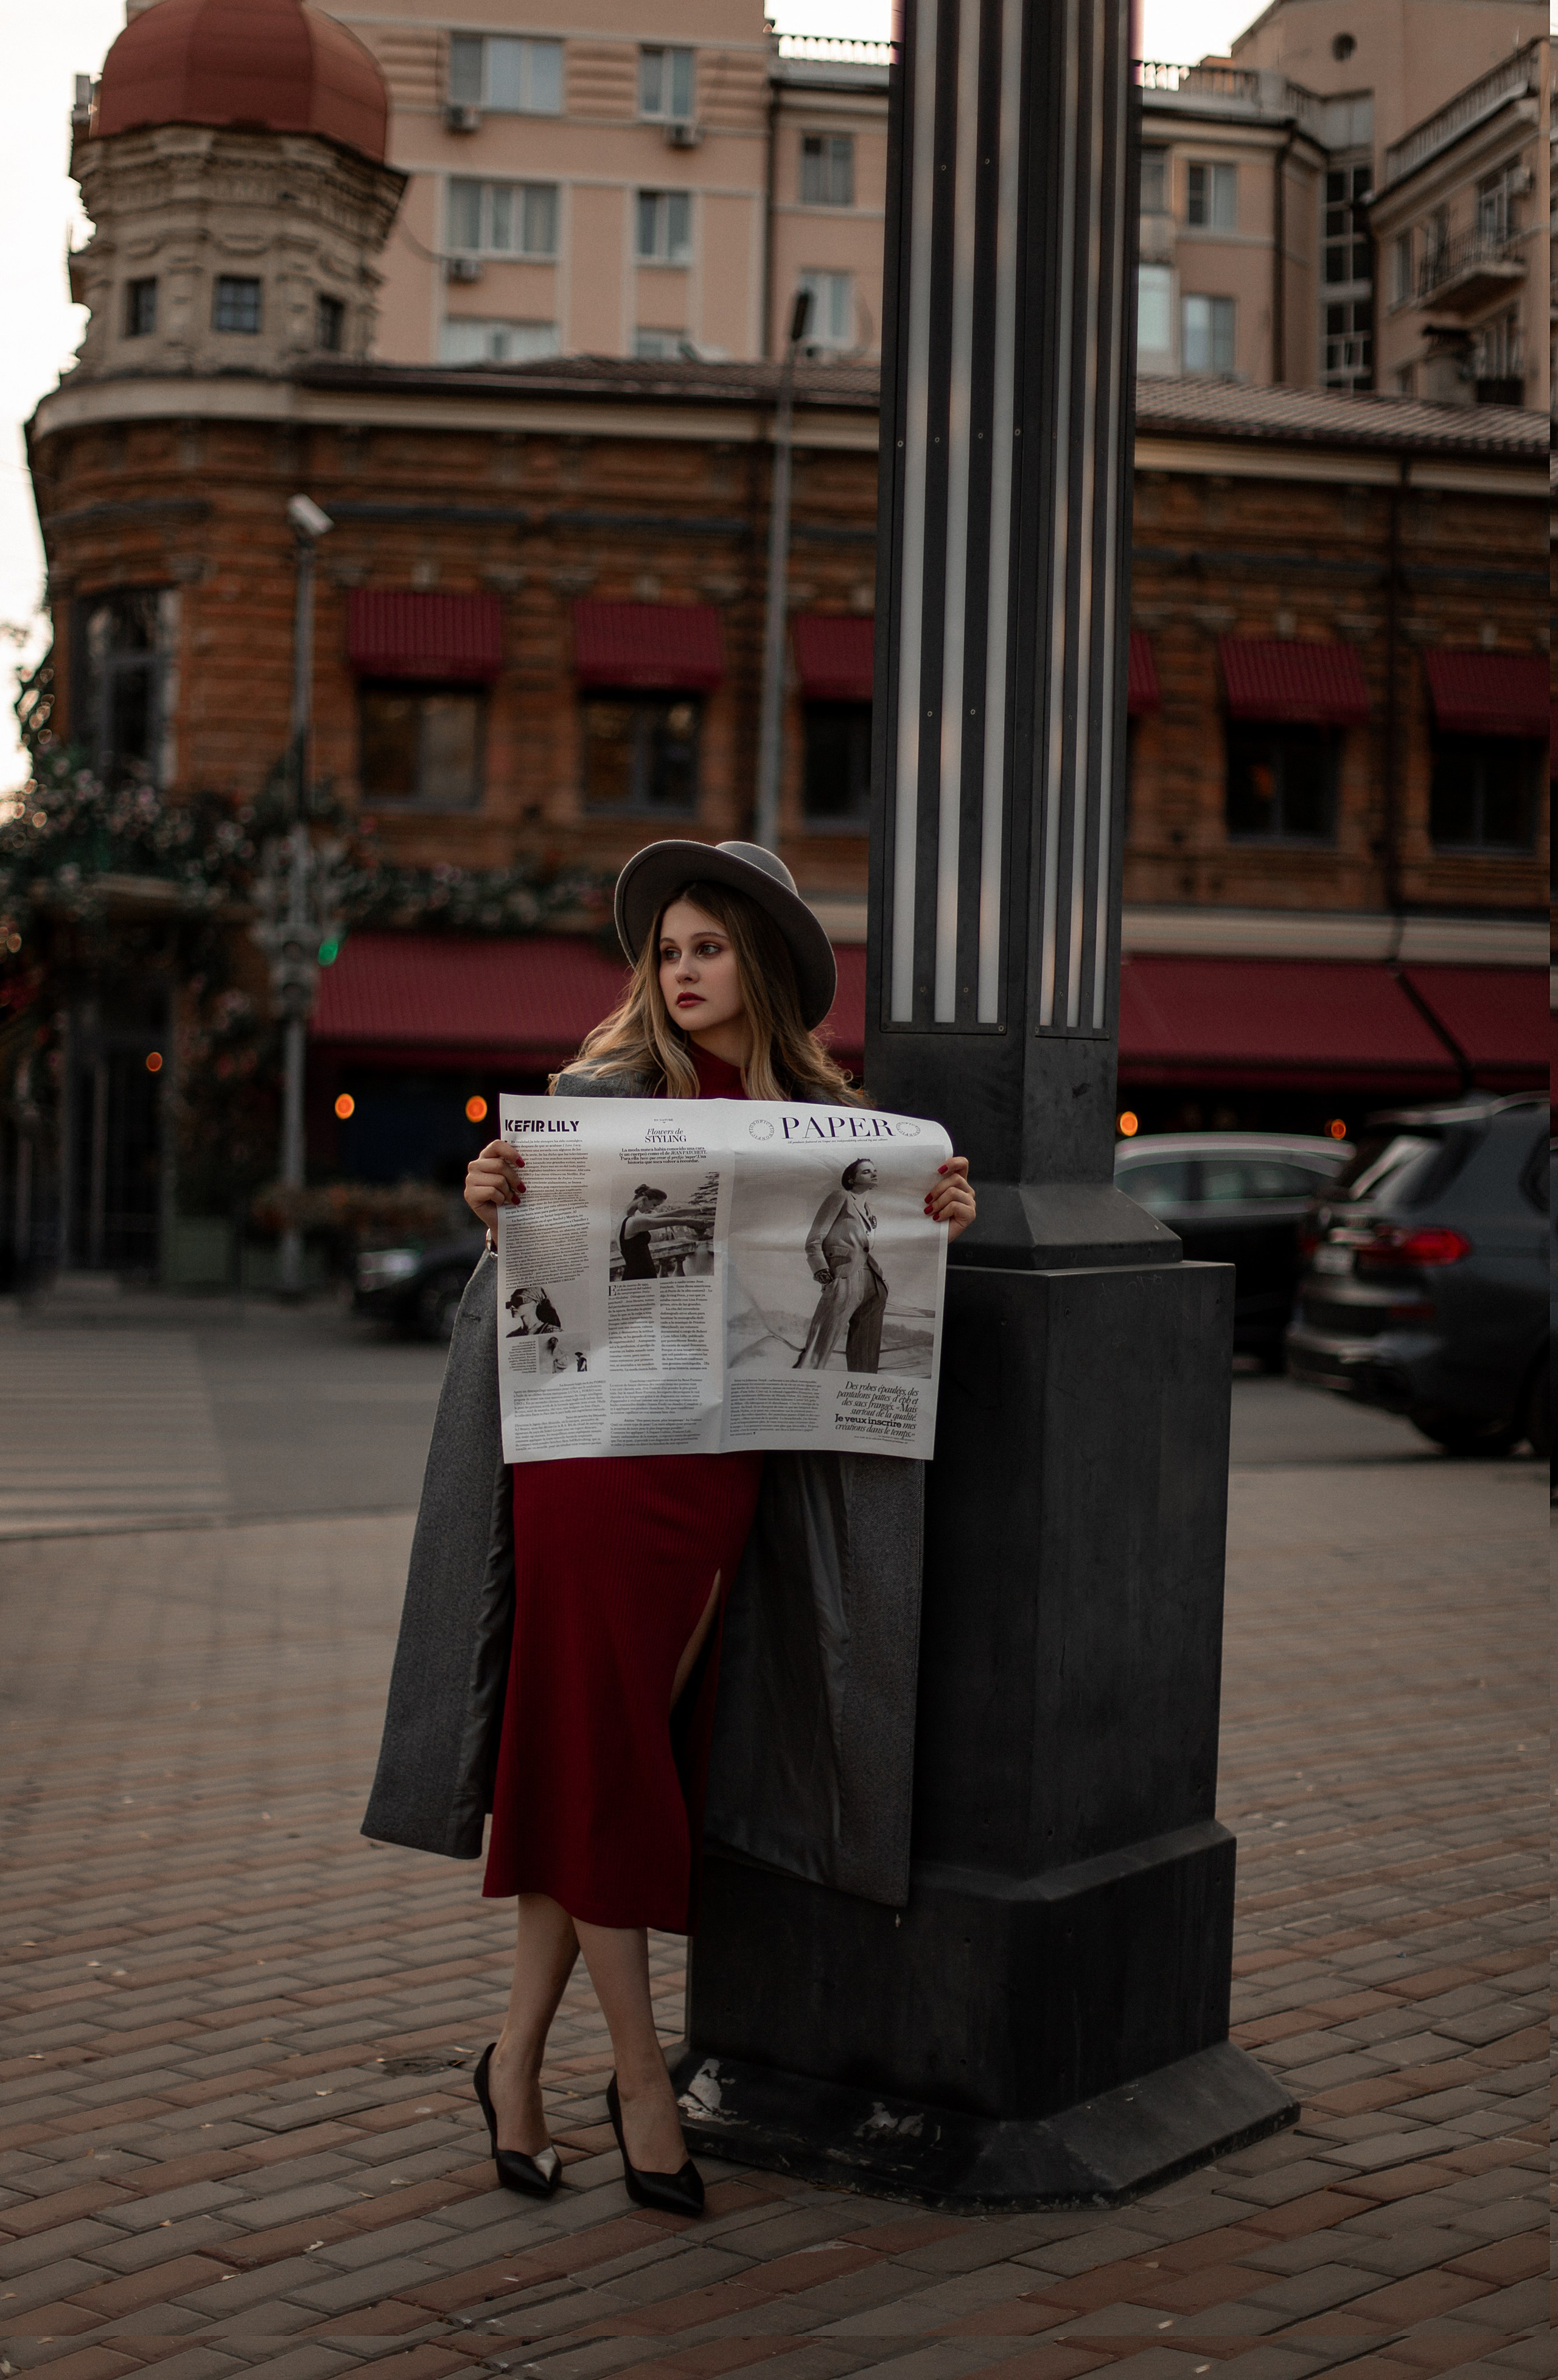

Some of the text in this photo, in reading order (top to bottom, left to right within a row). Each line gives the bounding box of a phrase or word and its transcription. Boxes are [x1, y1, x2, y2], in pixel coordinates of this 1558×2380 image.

[505, 1119, 579, 1132] KEFIR LILY
[778, 1117, 896, 1139] PAPER
[836, 1390, 872, 1399] pantalons
[845, 1381, 859, 1390] Des
[859, 1383, 878, 1392] robes
[907, 1387, 919, 1397] des
[841, 1397, 853, 1406] des
[875, 1409, 885, 1417] de
[834, 1413, 844, 1422] Je
[867, 1417, 901, 1428] inscrire
[866, 1425, 883, 1434] dans
